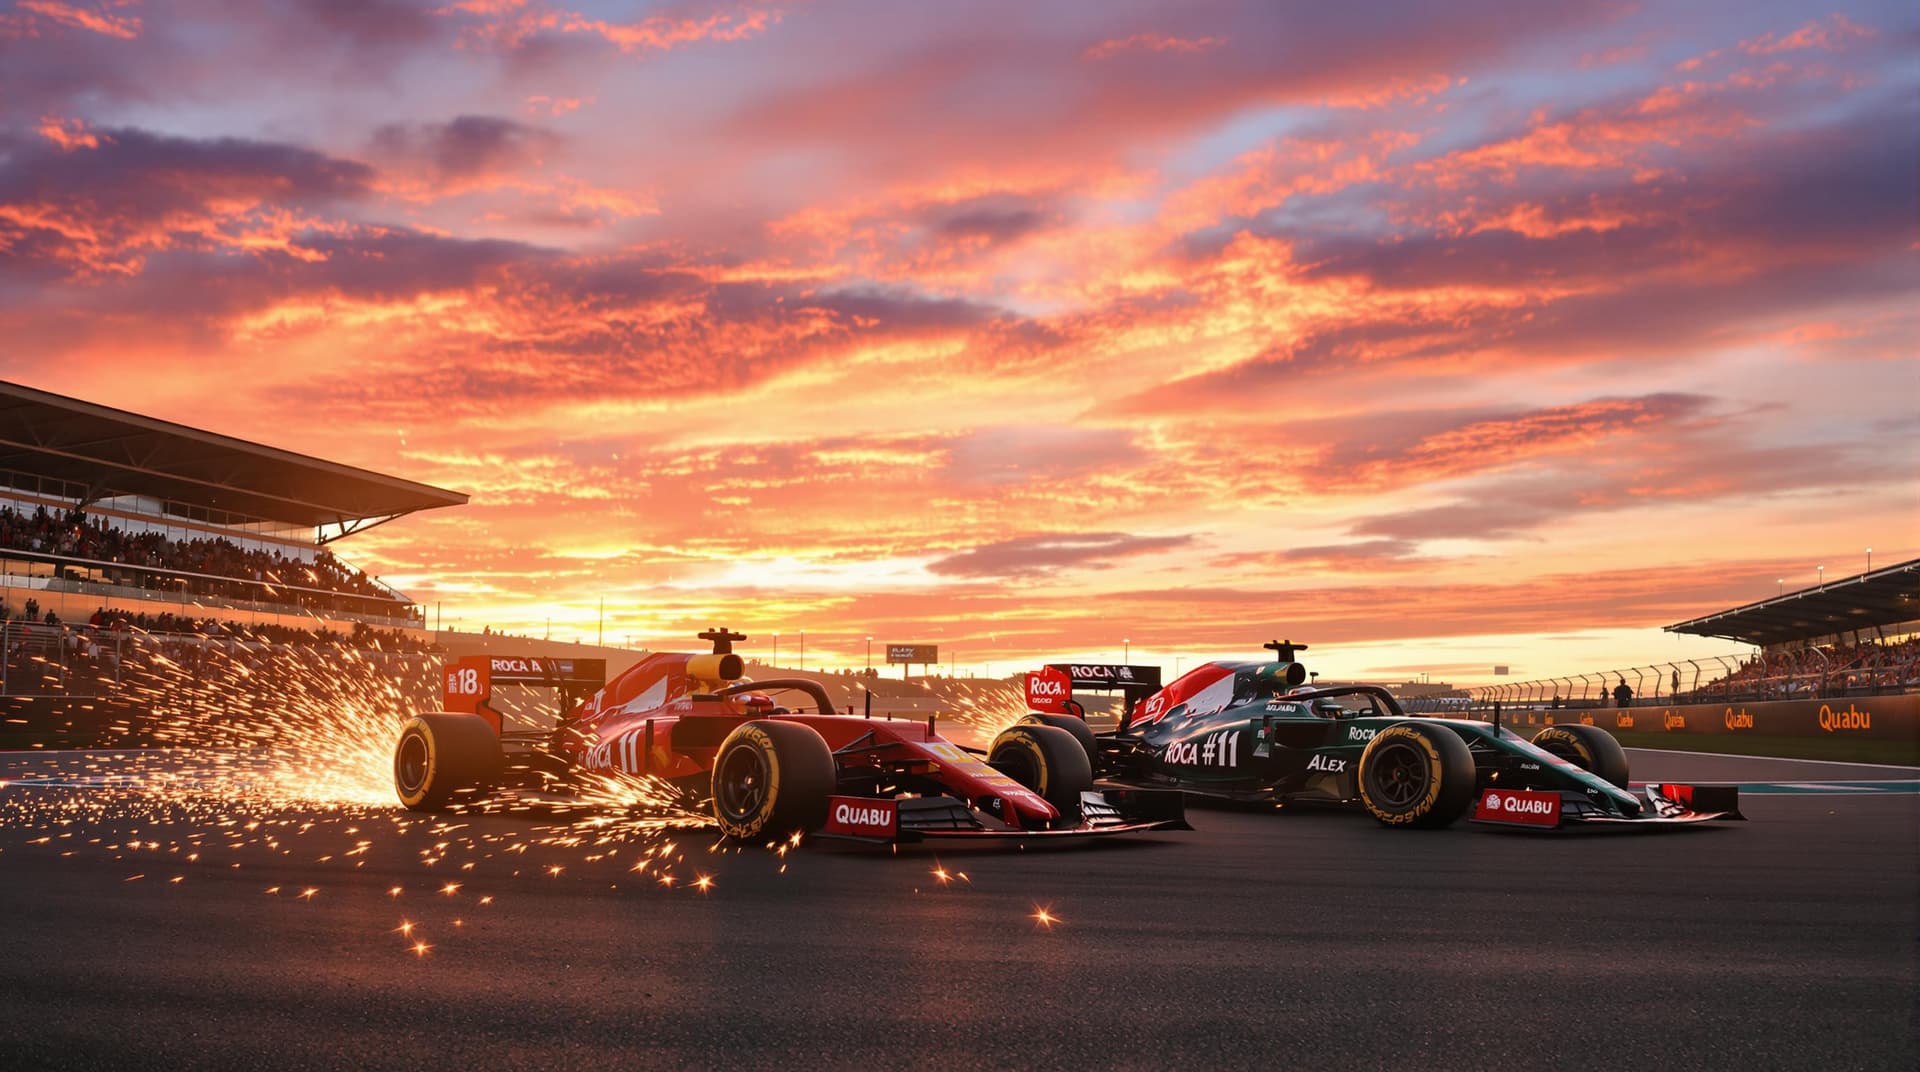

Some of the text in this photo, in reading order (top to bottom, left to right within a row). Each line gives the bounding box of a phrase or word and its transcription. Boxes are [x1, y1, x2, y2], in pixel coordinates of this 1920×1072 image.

[491, 659, 529, 672] ROCA
[1071, 665, 1114, 678] ROCA
[457, 668, 478, 694] 18
[1725, 707, 1754, 730] Quabu
[1819, 704, 1871, 732] Quabu
[618, 729, 641, 774] 11
[1164, 730, 1240, 768] ROCA #11
[1306, 753, 1347, 772] ALEX
[835, 804, 892, 826] QUABU
[1504, 796, 1553, 814] QUABU
